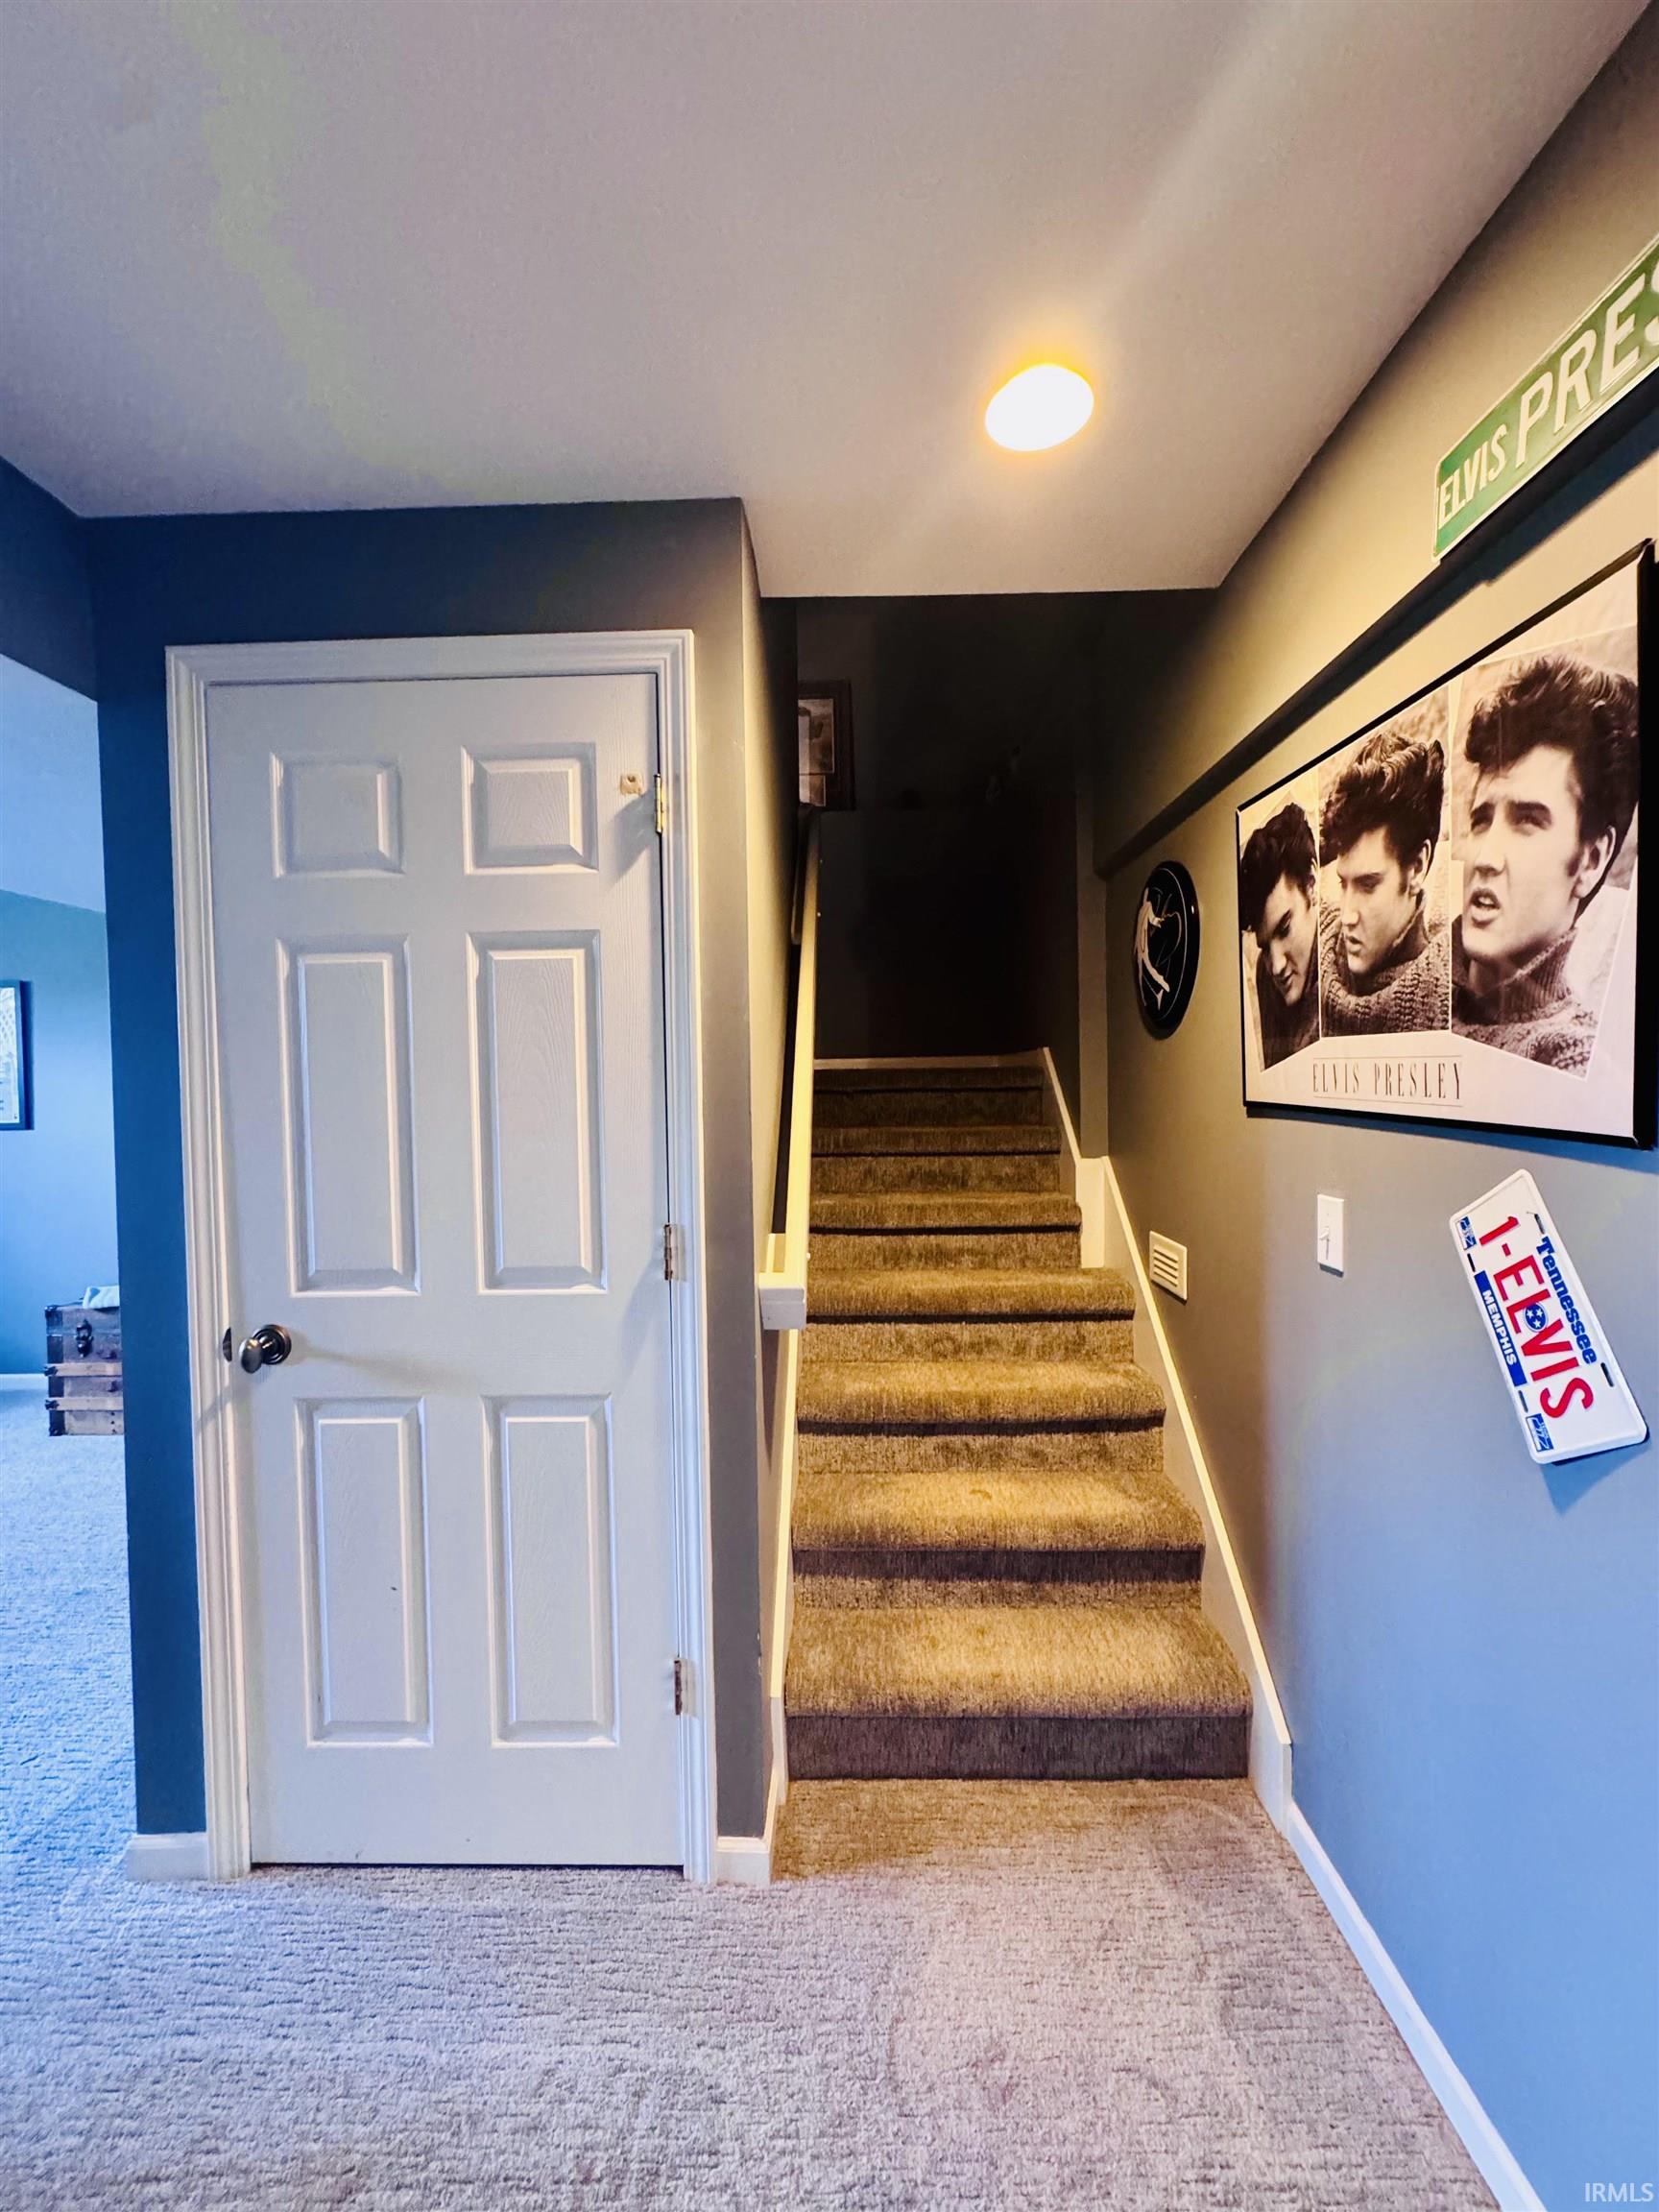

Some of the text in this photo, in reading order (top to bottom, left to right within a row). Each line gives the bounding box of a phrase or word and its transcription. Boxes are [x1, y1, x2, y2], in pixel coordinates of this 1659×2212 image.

[1438, 423, 1507, 530] ELVIS
[1312, 1062, 1461, 1100] ELVIS PRESLEY
[1479, 1215, 1595, 1419] 1-ELVIS
[1482, 1289, 1517, 1365] MEMPHIS
[1536, 1237, 1597, 1364] Tennessee
